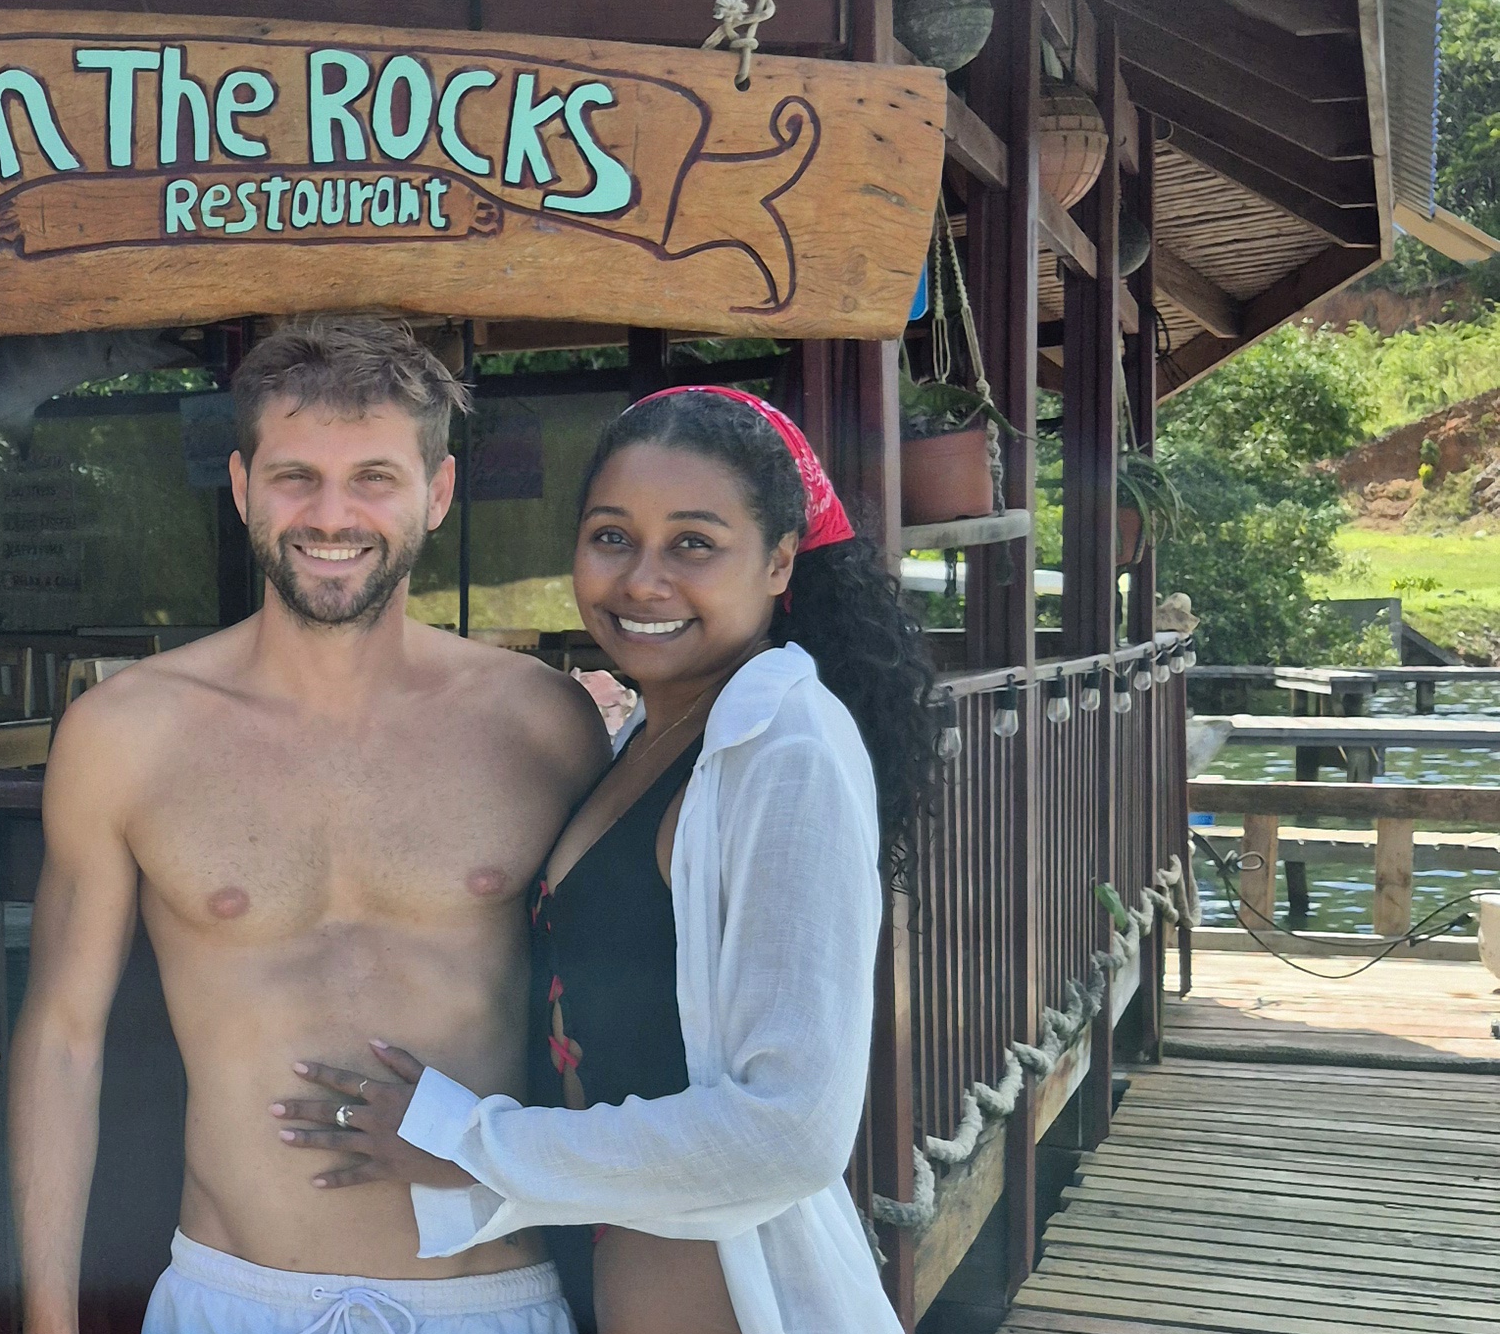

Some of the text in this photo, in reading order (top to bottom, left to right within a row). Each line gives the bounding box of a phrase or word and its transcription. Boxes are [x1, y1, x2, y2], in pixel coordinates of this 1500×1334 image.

[74, 44, 276, 169] The
[308, 47, 634, 215] ROCKS
[164, 175, 450, 234] Restaurant
